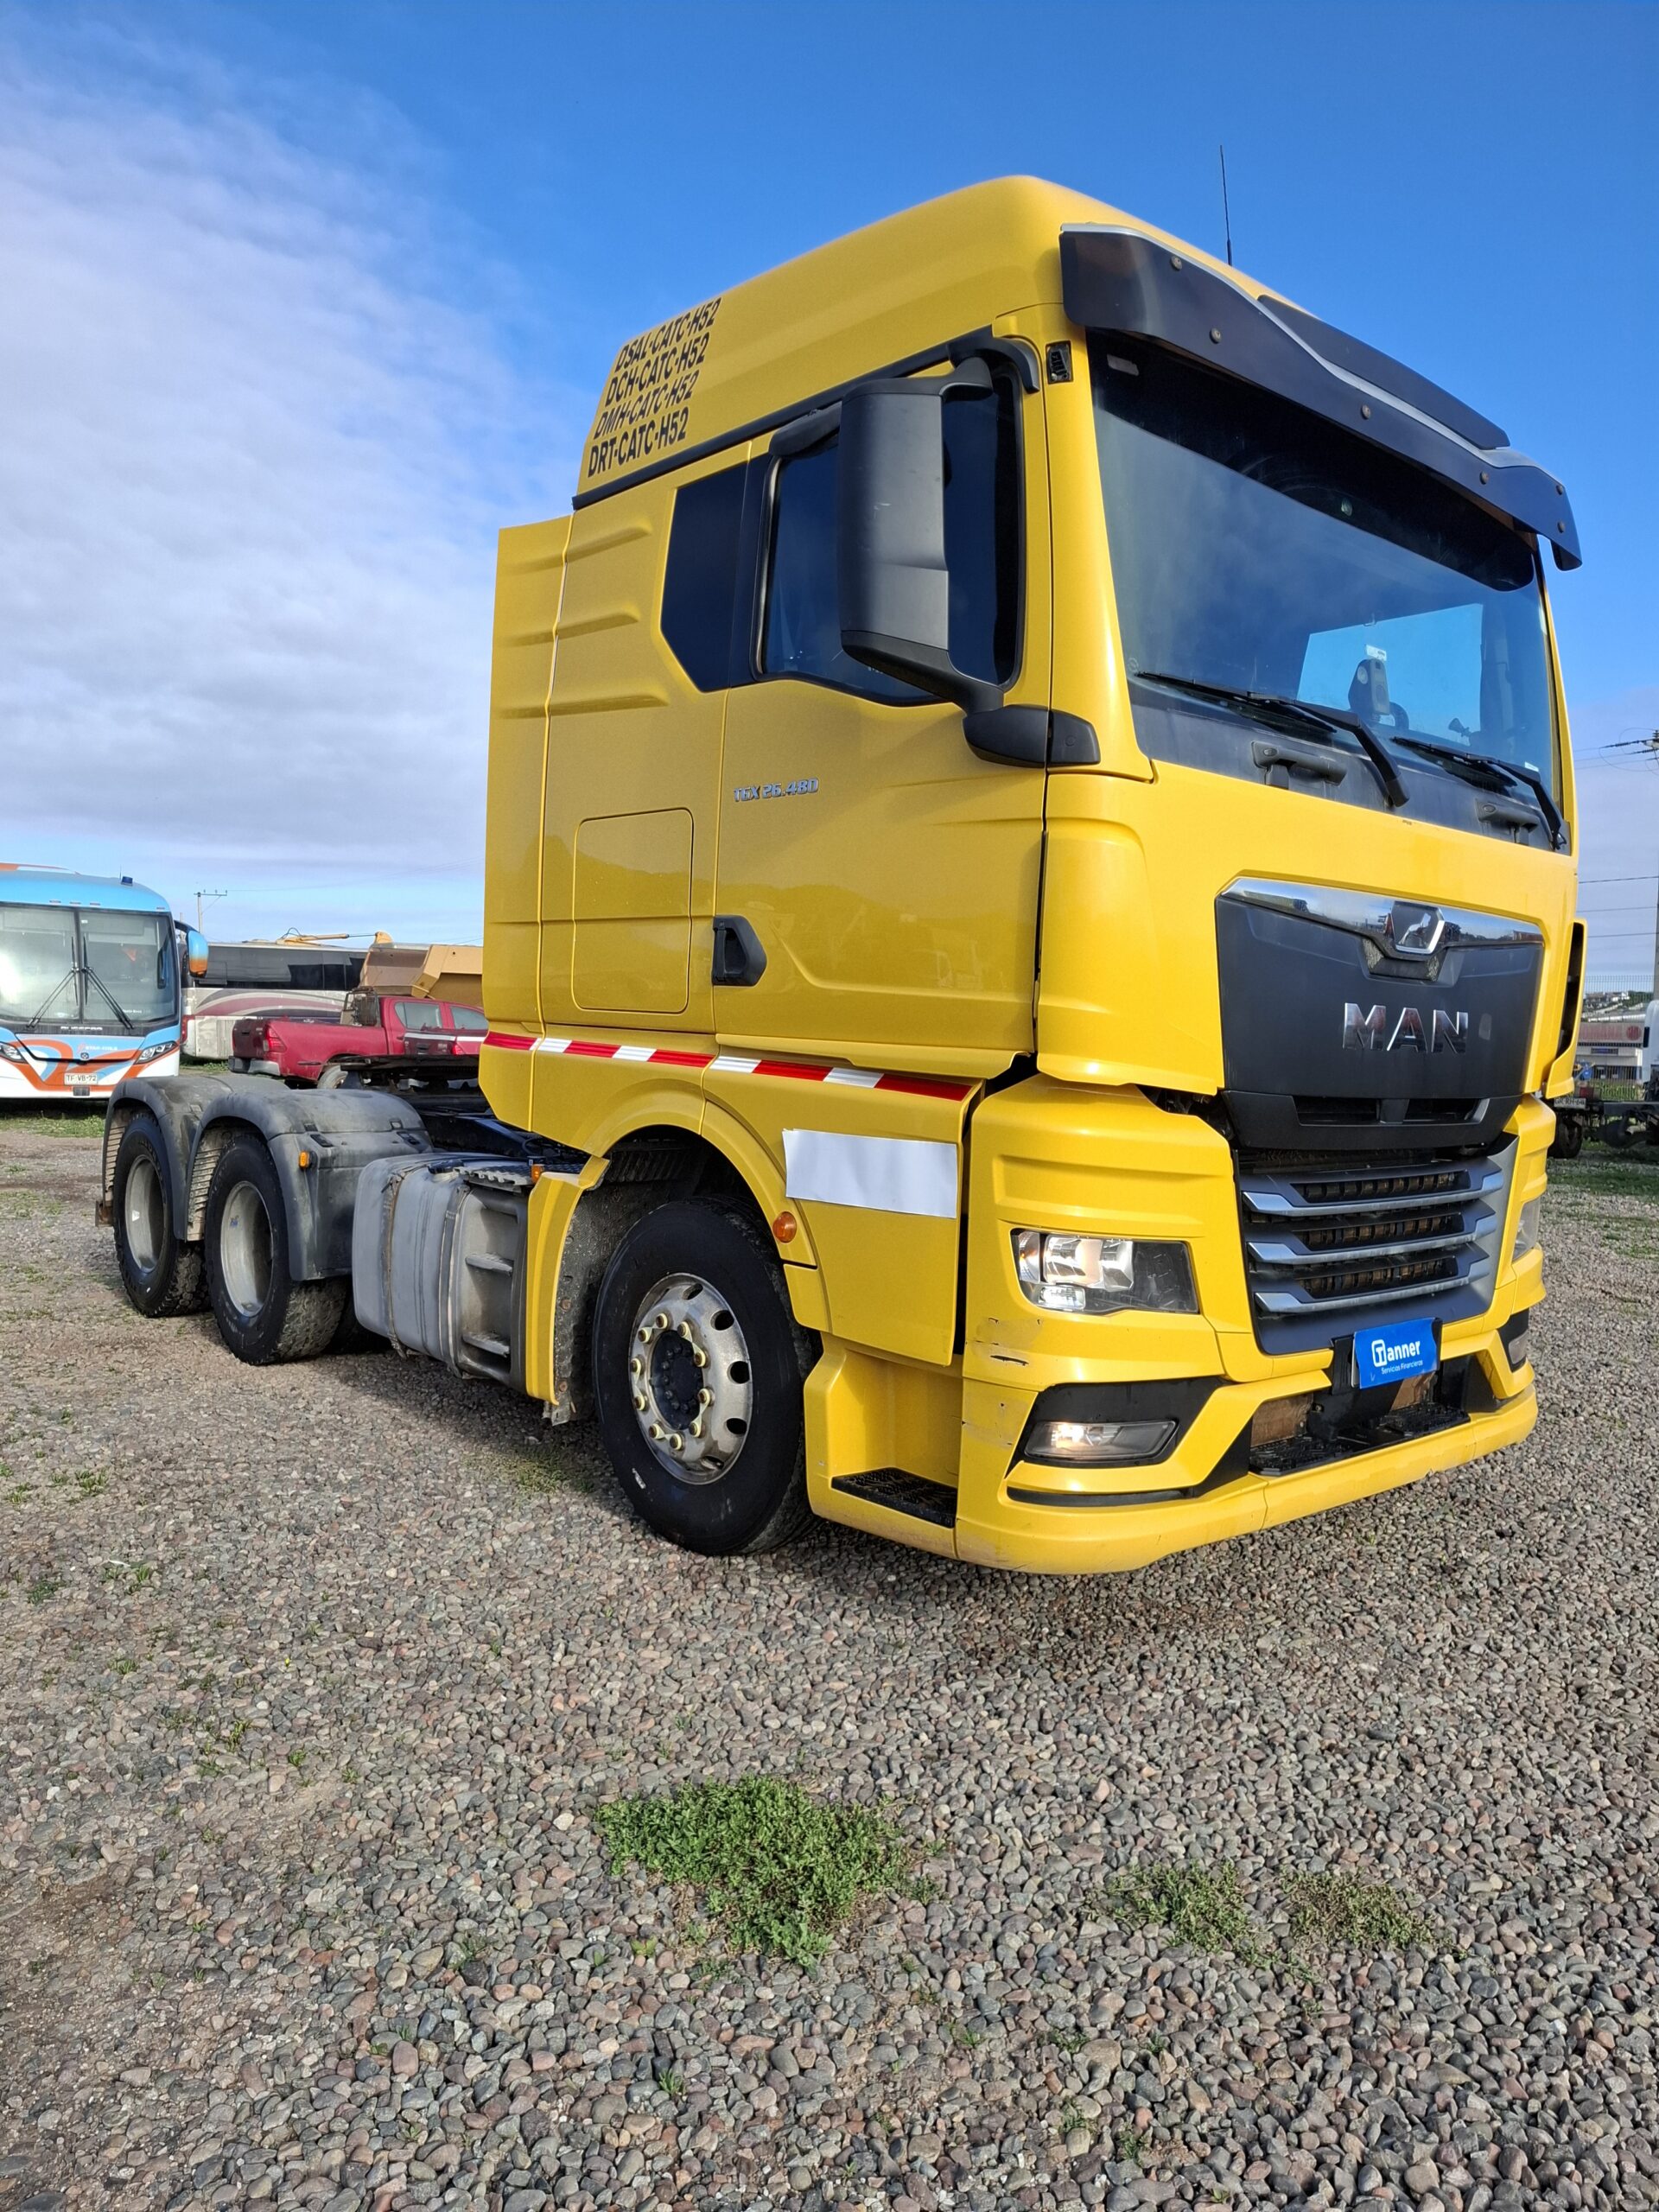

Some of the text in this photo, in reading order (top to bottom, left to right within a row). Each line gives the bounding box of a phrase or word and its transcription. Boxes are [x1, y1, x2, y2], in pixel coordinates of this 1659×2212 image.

[605, 332, 710, 407] DCH-CATC-H52
[594, 370, 700, 440] DMH-CATC-H52
[587, 407, 690, 478] DRT-CATC-H52
[734, 778, 819, 802] TGX 26.480
[1342, 1002, 1469, 1054] MAN
[1371, 1339, 1421, 1368] Tanner
